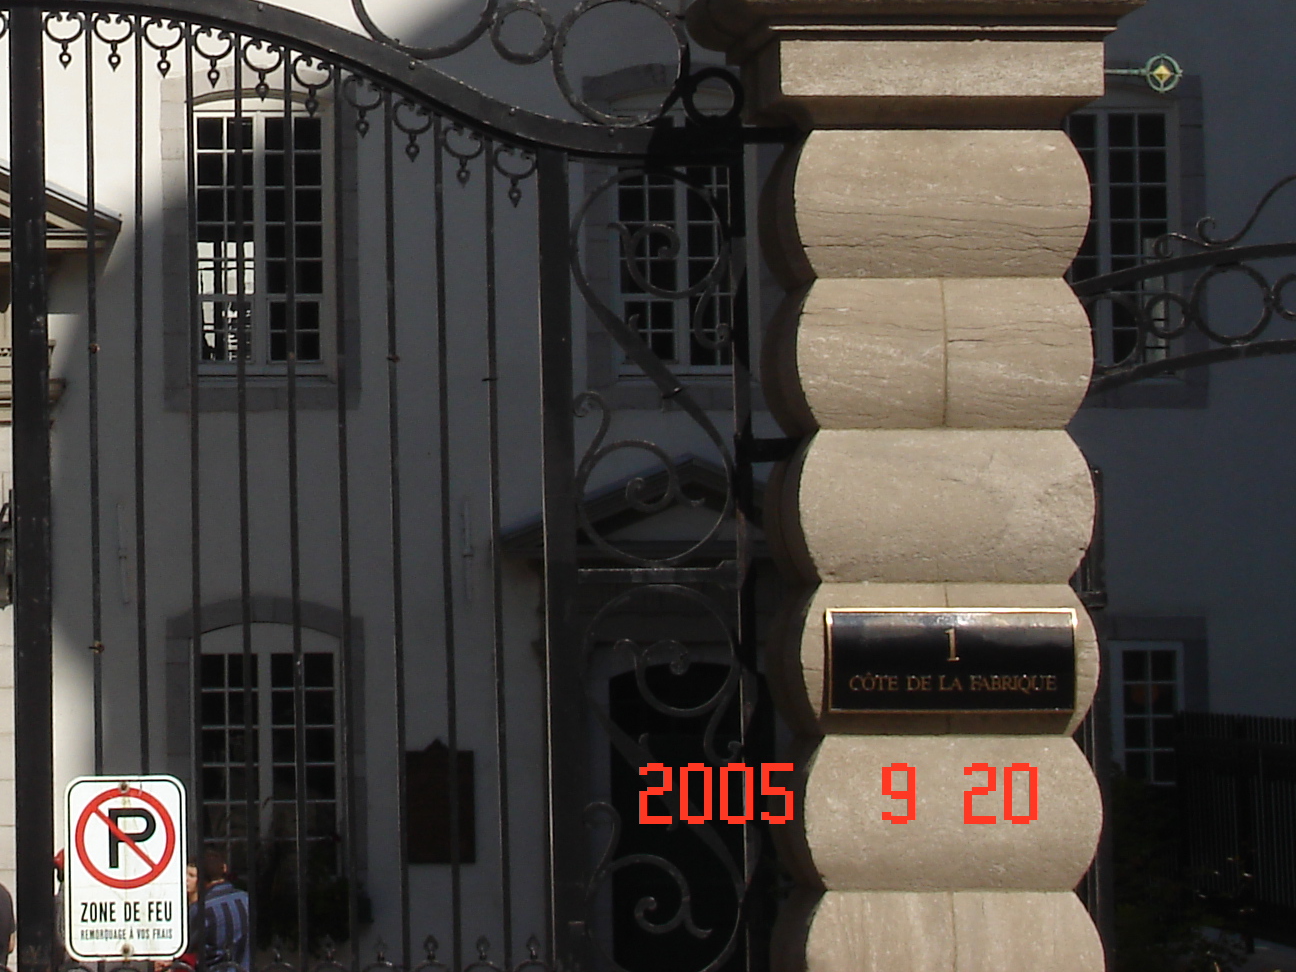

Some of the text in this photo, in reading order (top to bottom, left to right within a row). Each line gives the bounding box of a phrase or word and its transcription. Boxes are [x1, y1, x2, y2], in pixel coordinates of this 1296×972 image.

[944, 629, 960, 662] 1
[848, 672, 1057, 696] CÔTE DE LA FABRIQUE
[80, 901, 172, 922] ZONE DE FEU
[80, 928, 127, 941] REMORQUAGE
[137, 928, 150, 940] VOS
[153, 928, 173, 940] FRAIS
